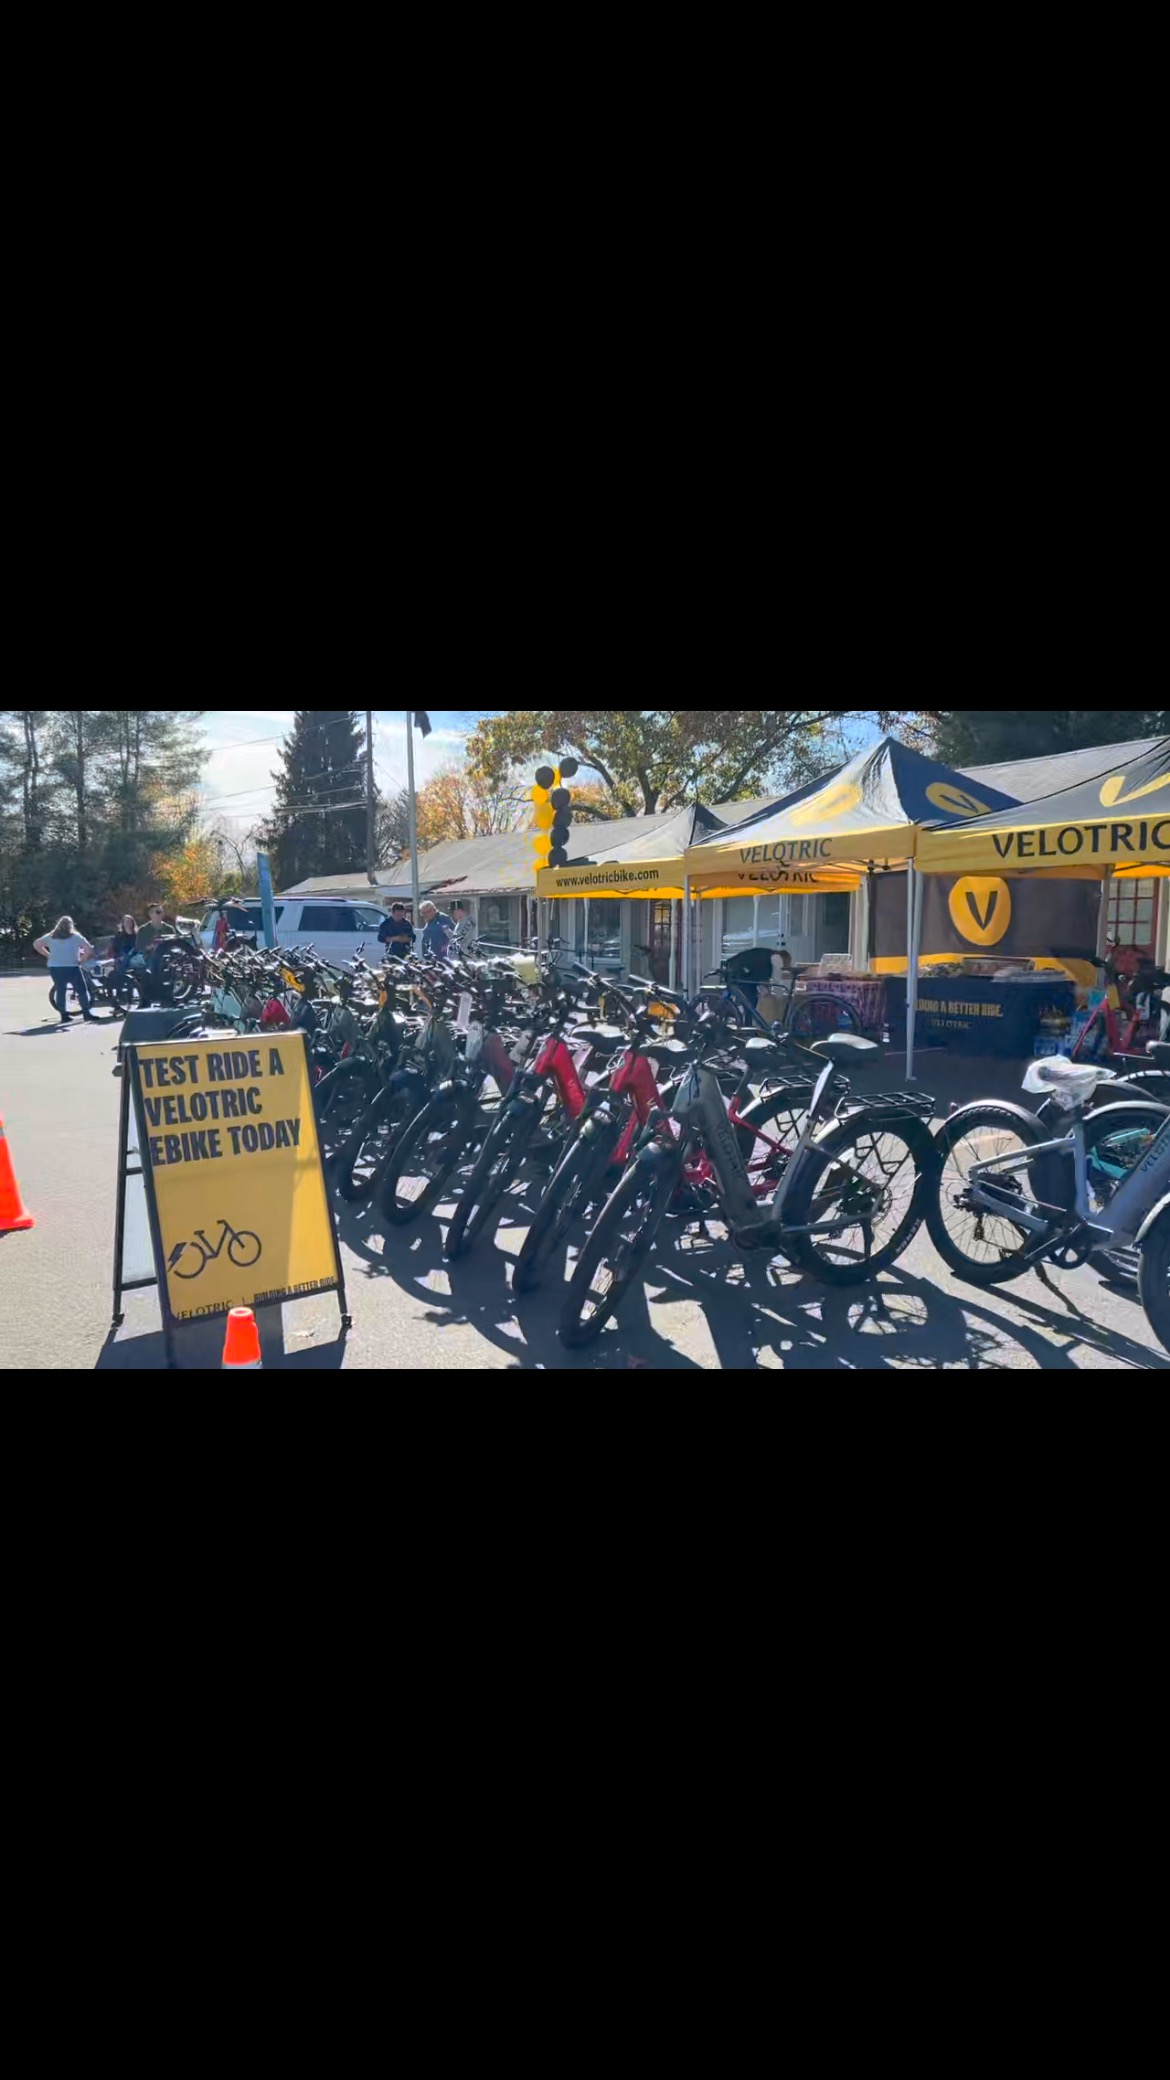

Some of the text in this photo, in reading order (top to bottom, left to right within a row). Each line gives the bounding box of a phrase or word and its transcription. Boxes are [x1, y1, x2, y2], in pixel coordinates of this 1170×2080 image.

[740, 838, 832, 864] VELOTRIC
[992, 819, 1170, 859] VELOTRIC
[555, 869, 659, 887] www.velotricbike.com
[965, 890, 998, 931] V
[138, 1048, 285, 1088] TEST RIDE A
[144, 1086, 263, 1127] VELOTRIC
[149, 1118, 301, 1166] EBIKE TODAY
